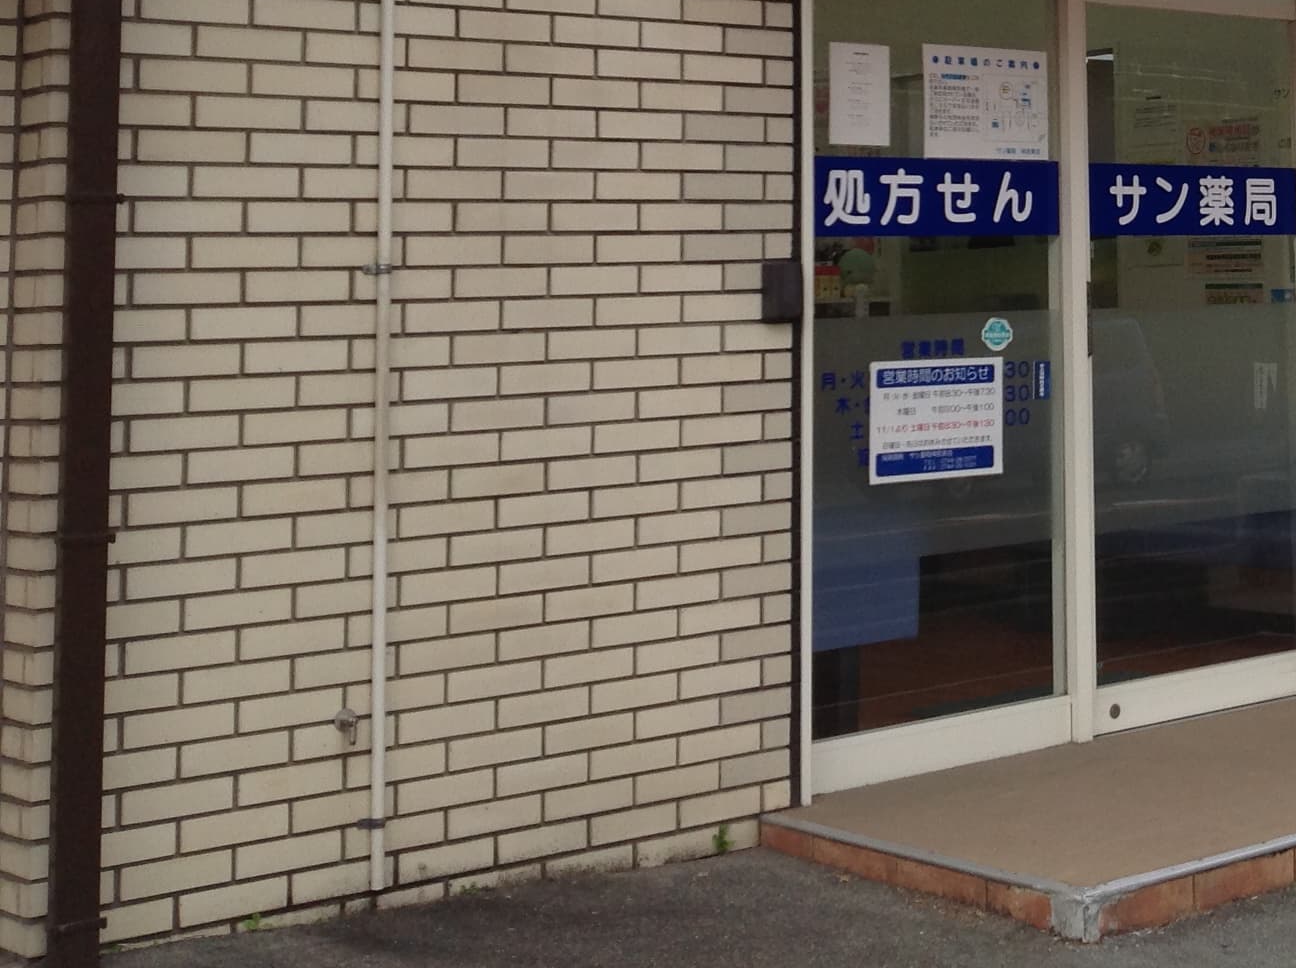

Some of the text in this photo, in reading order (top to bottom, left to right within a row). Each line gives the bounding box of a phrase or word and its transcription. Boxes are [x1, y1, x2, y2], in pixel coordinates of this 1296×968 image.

[823, 168, 1033, 227] 処方せん
[1109, 174, 1278, 227] サン薬局
[882, 367, 989, 385] 営業時間のお知らせ
